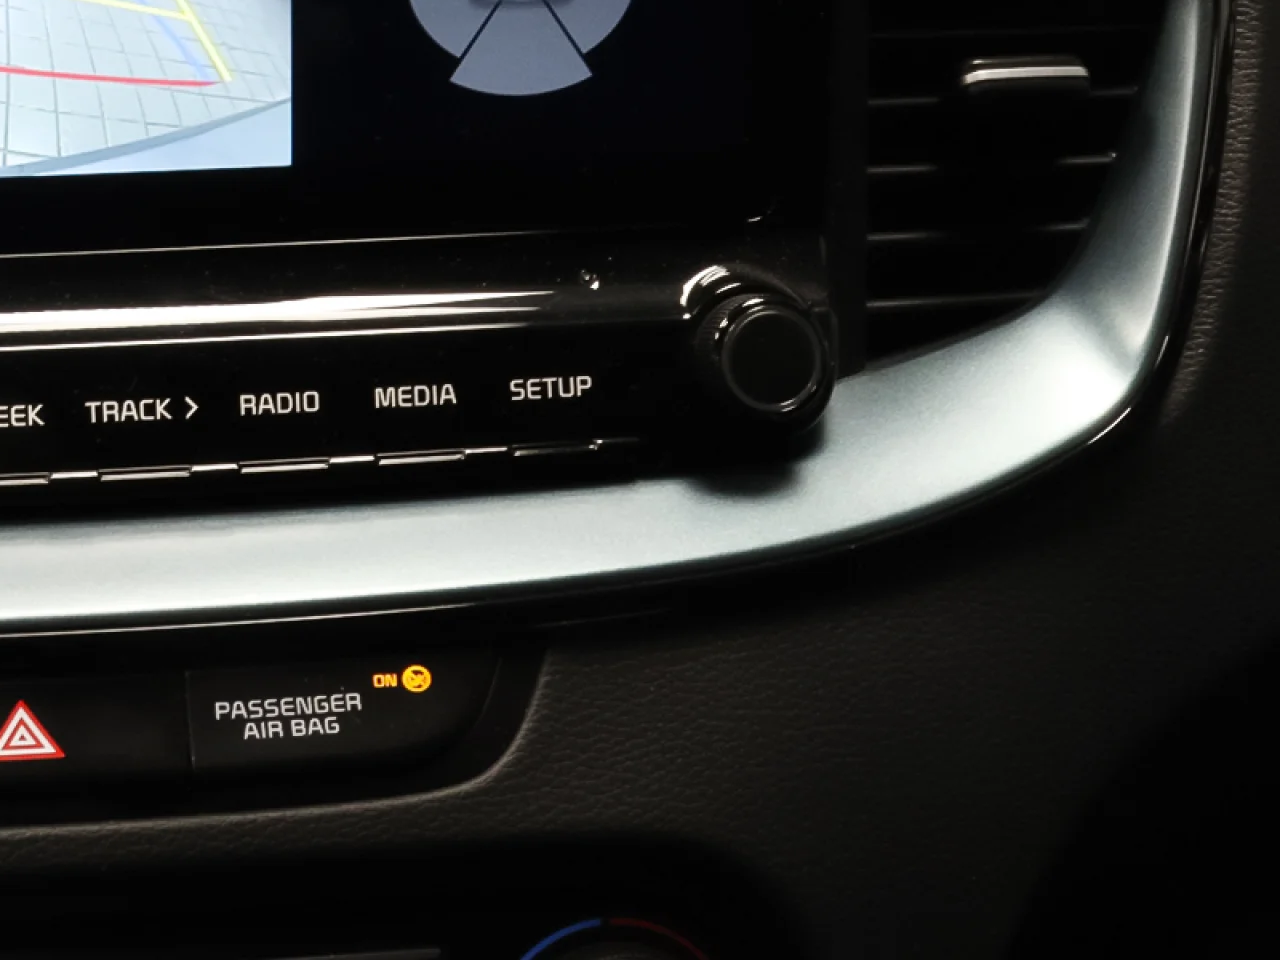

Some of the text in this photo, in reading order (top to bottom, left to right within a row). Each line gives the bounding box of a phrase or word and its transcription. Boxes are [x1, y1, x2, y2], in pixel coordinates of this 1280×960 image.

[374, 383, 457, 409] MEDIA
[509, 375, 592, 401] SETUP
[84, 397, 172, 424] TRACK
[239, 391, 320, 417] RADIO
[372, 672, 398, 689] ON
[214, 692, 363, 721] PASSENGER
[243, 716, 340, 741] AIR BAG
